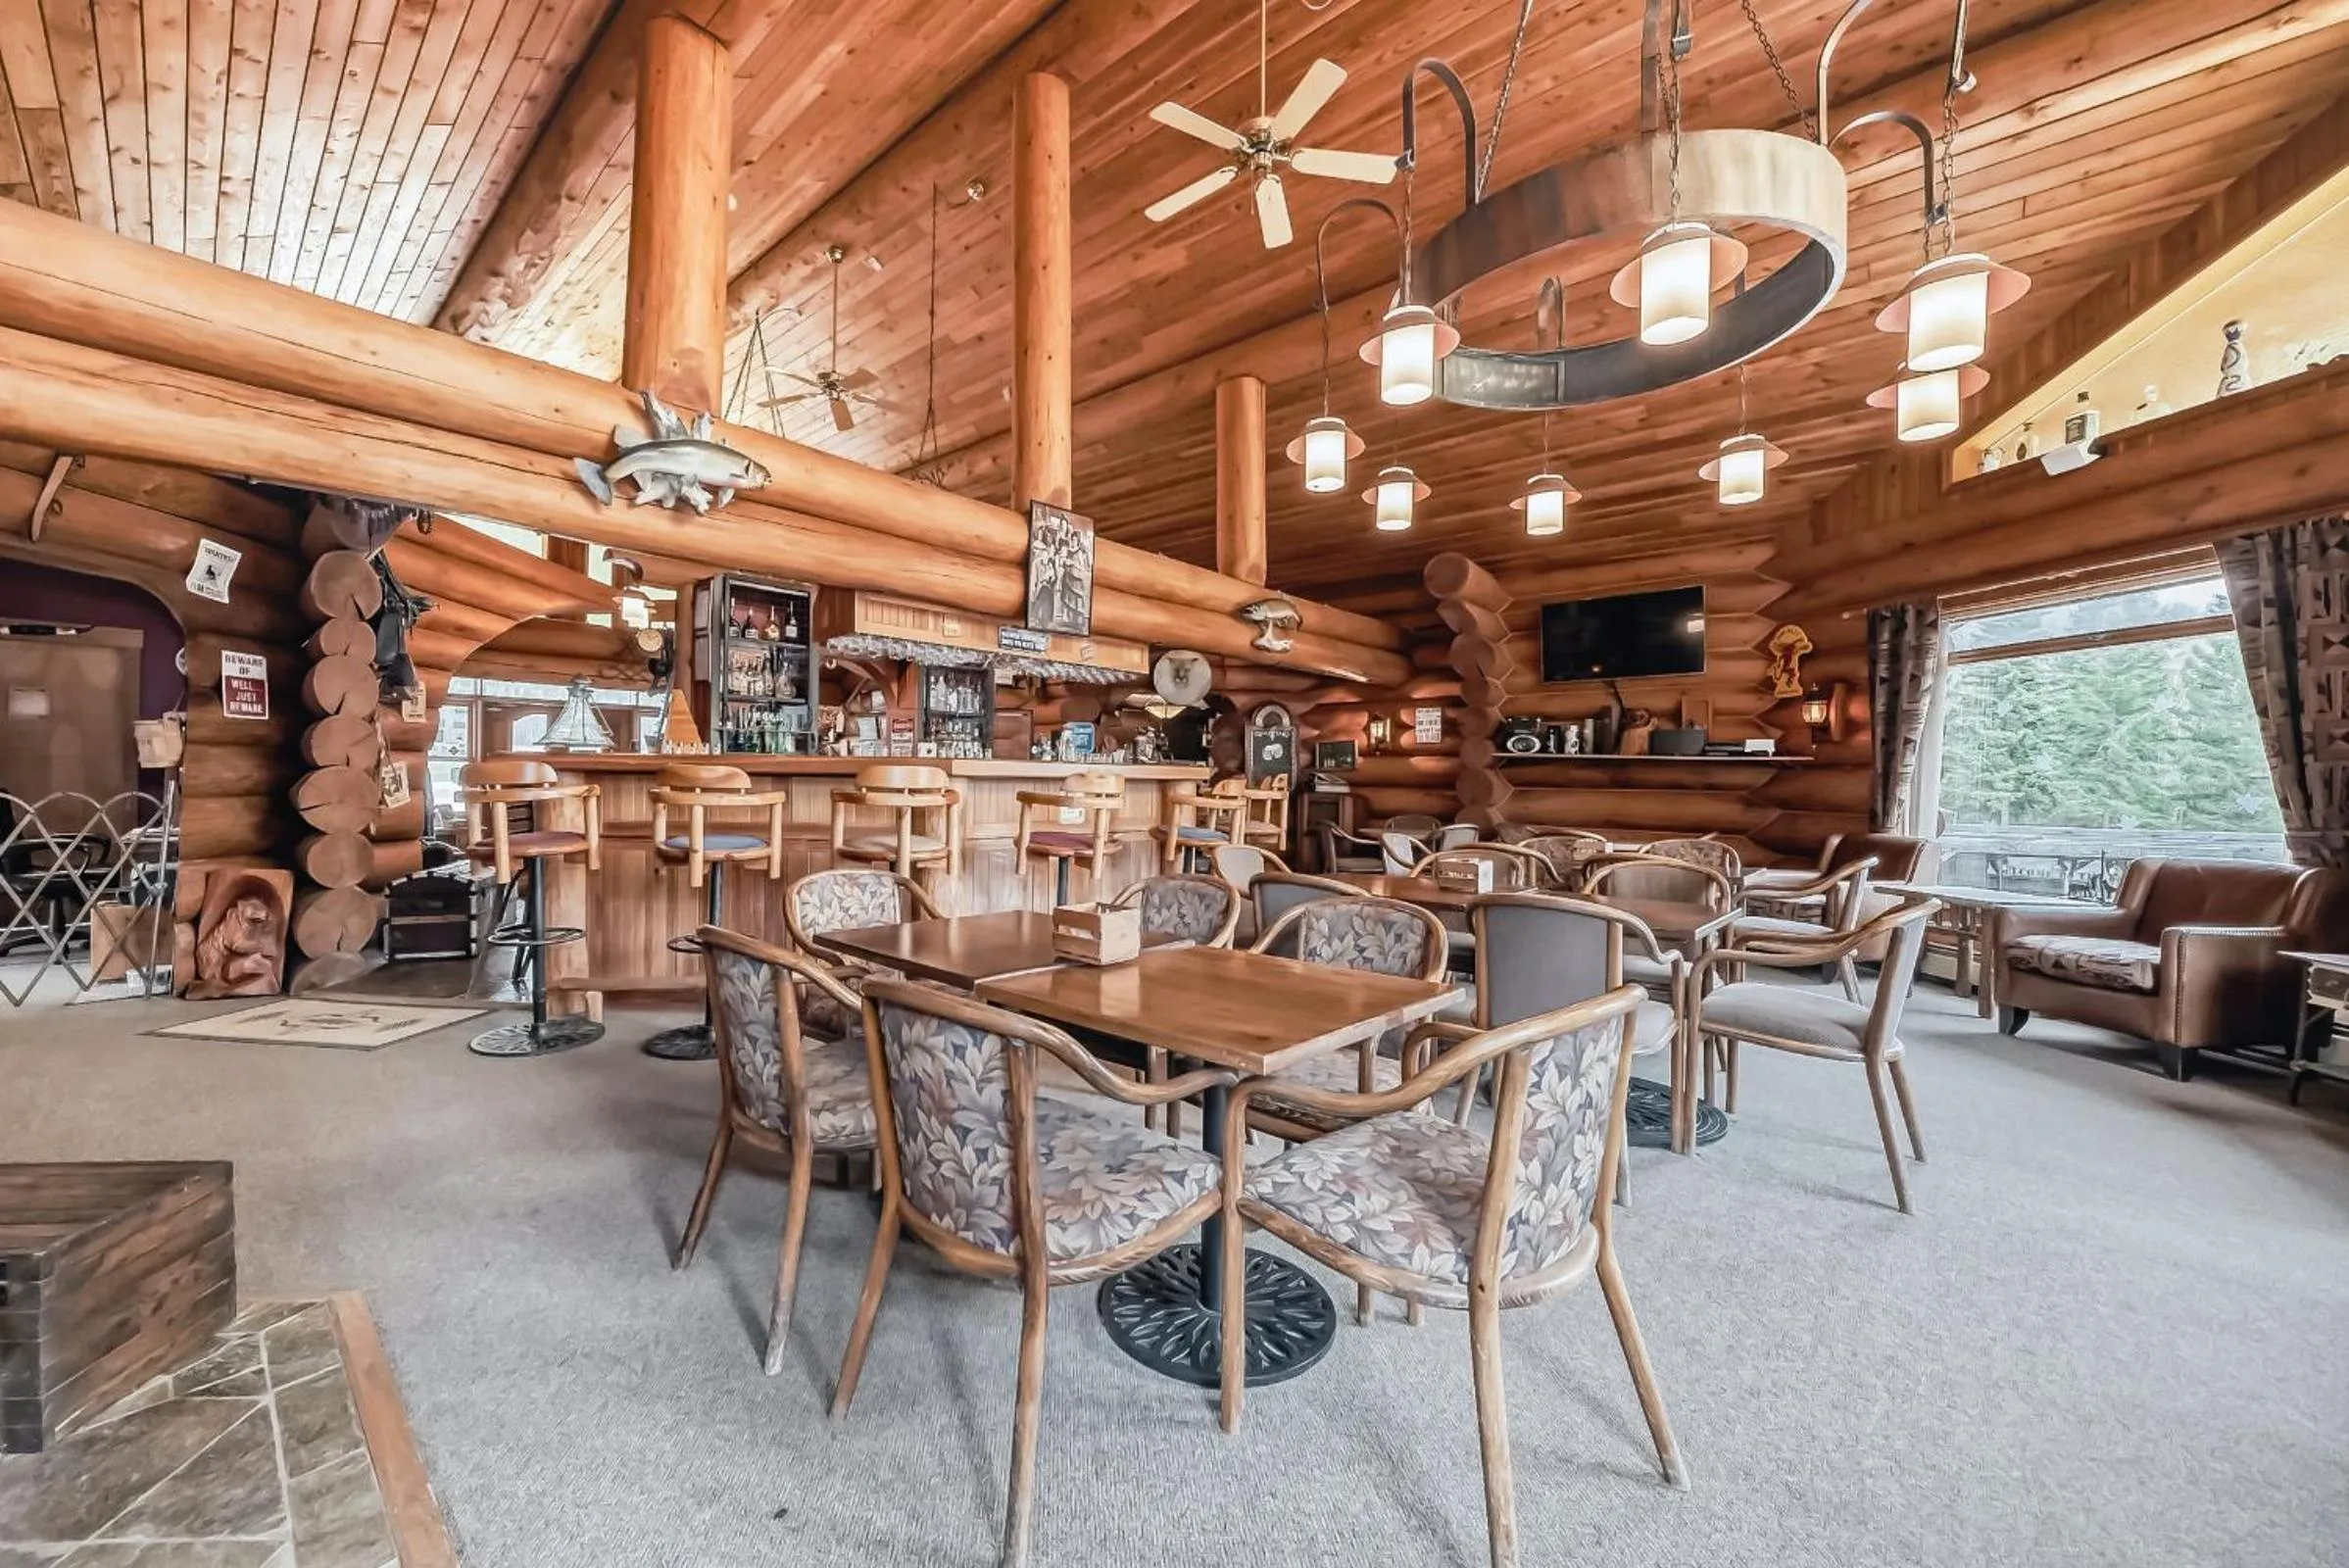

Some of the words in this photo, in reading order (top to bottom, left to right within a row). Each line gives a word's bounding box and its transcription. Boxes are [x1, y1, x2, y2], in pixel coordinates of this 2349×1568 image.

[224, 654, 264, 667] BEWARE
[239, 666, 251, 675] OF
[235, 691, 257, 703] JUST
[229, 702, 264, 713] BEWARE
